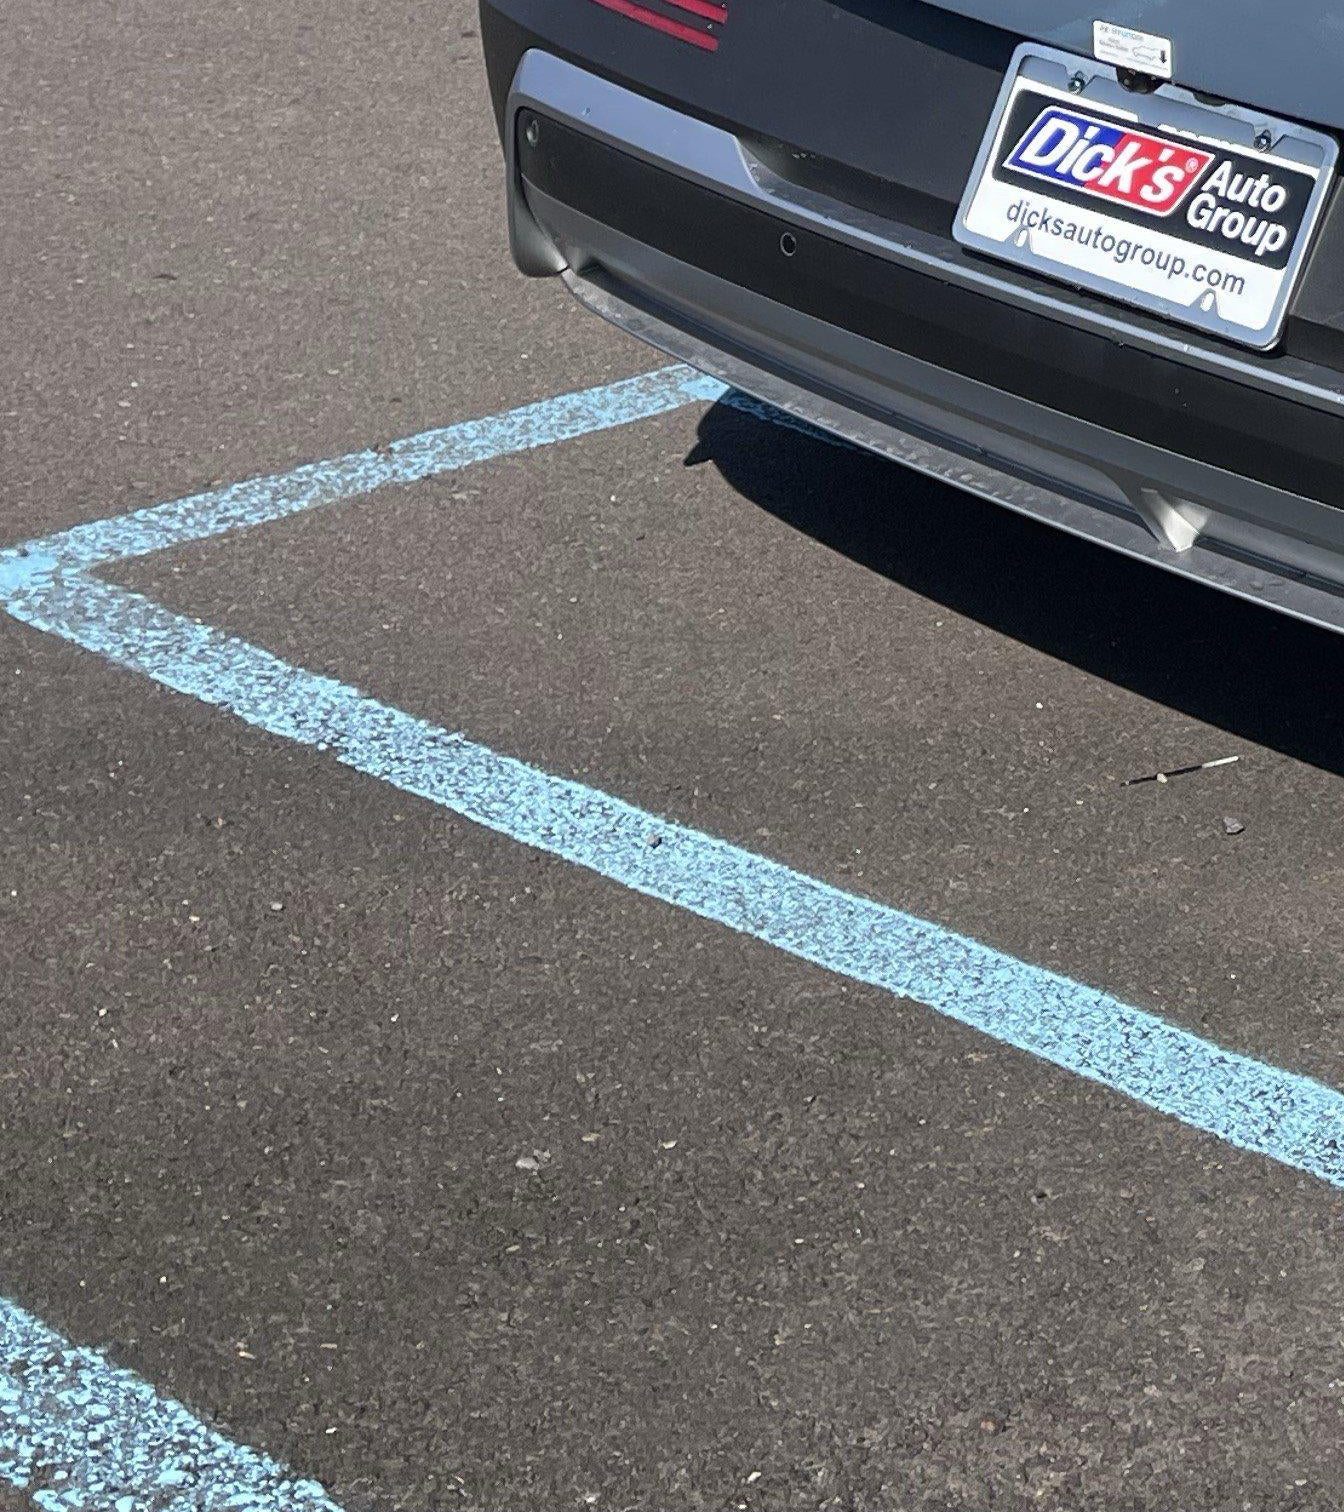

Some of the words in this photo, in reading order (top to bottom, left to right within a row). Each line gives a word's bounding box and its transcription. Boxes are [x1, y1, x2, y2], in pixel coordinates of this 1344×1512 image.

[1018, 116, 1187, 204] Dick's
[1201, 161, 1288, 212] Auto
[1005, 199, 1246, 296] dicksautogroup.com
[1186, 196, 1289, 256] Group
